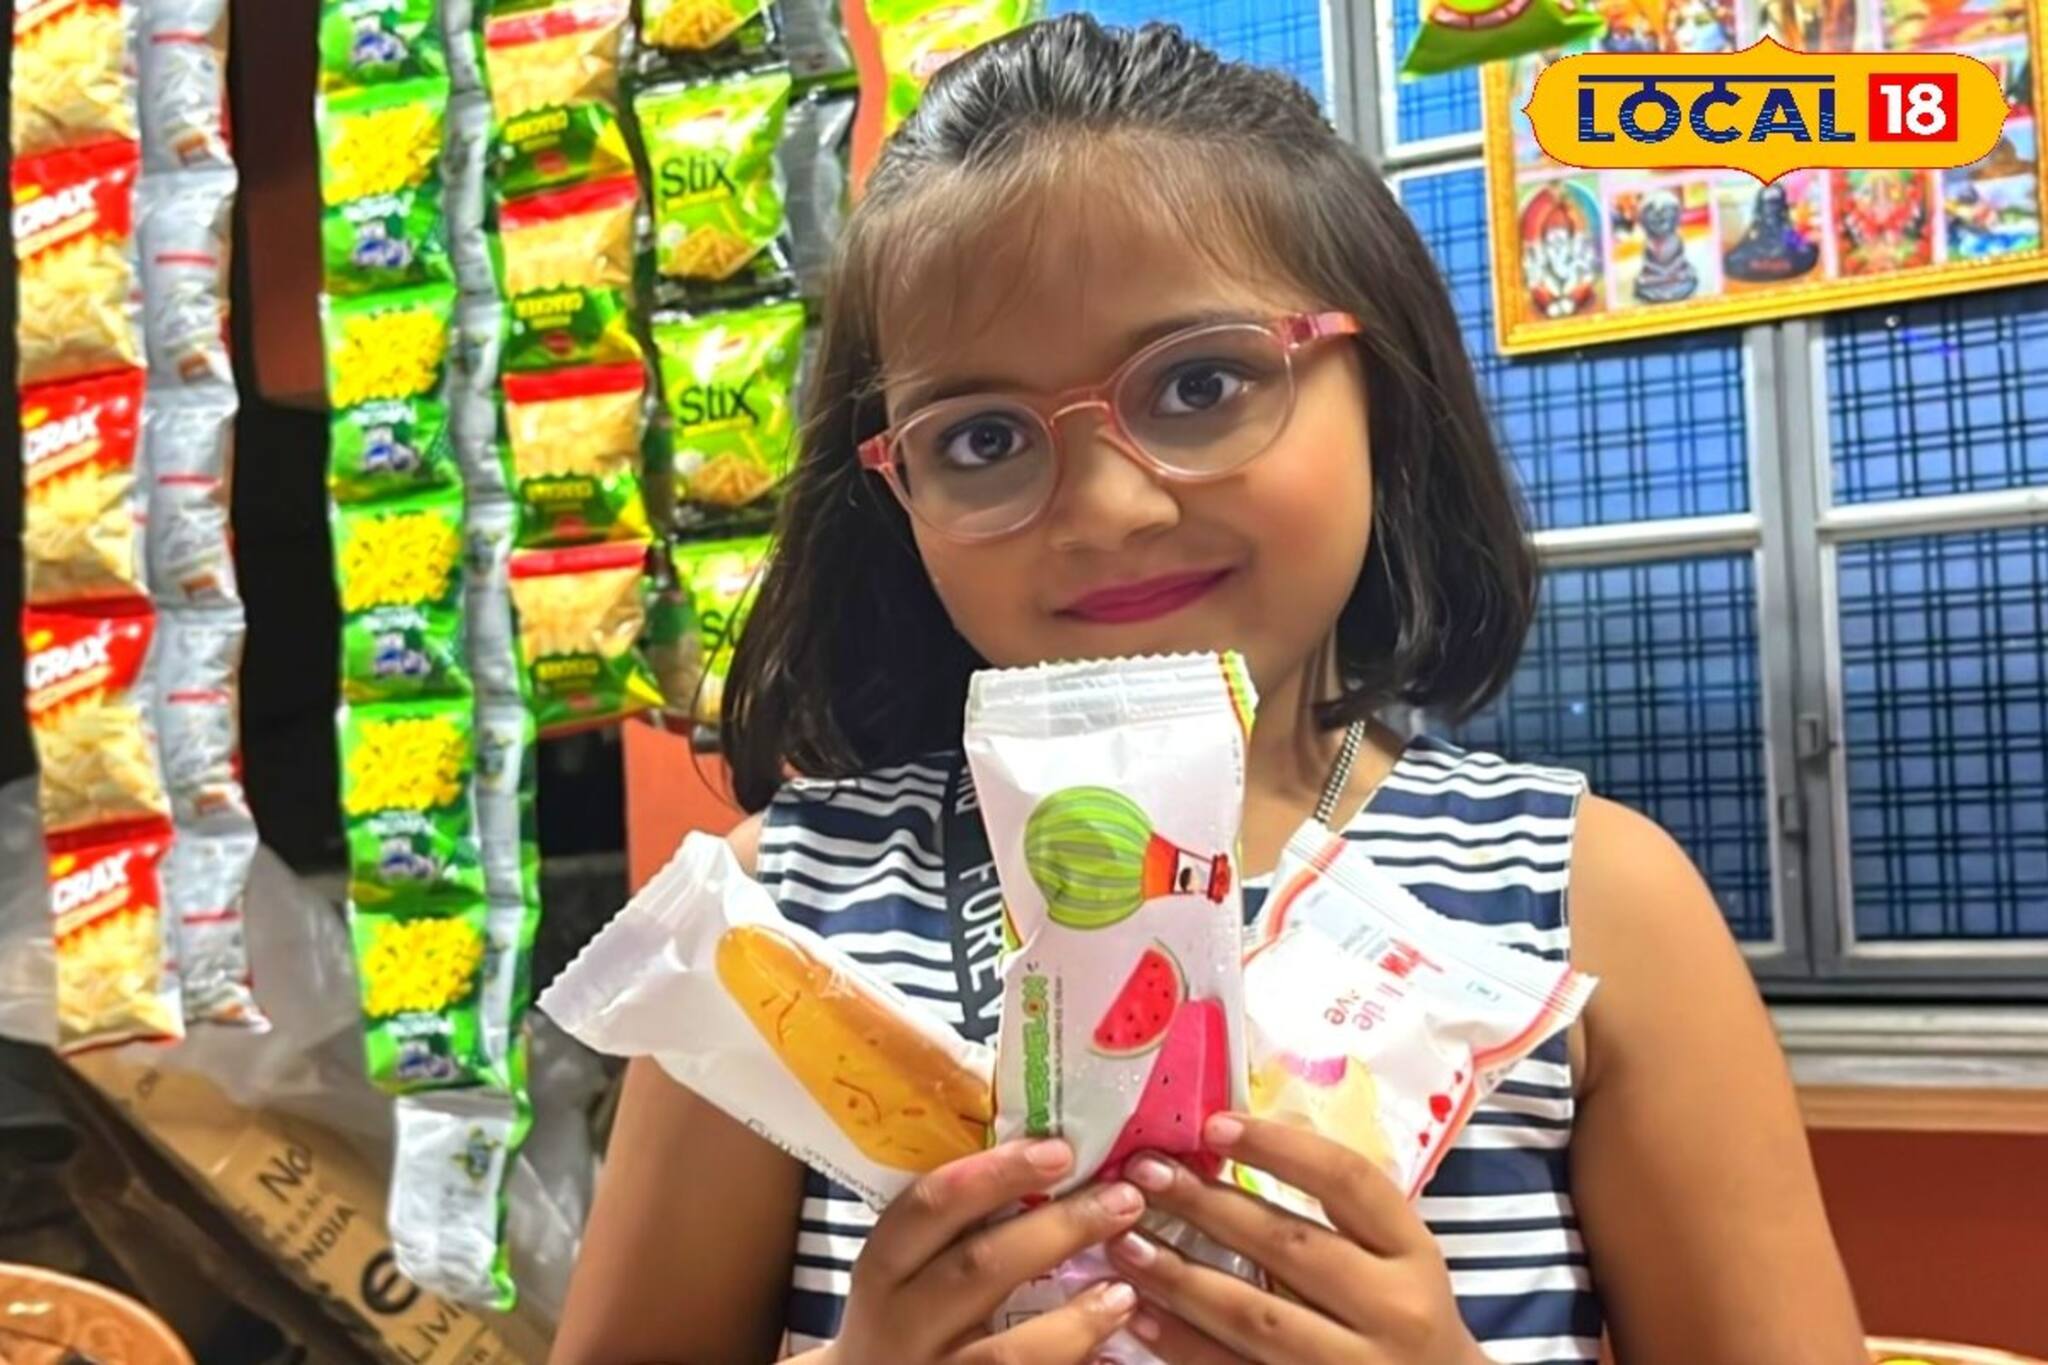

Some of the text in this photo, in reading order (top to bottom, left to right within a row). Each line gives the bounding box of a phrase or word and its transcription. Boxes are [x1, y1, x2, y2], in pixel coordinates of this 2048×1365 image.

[661, 147, 737, 198] Stix
[12, 178, 99, 238] CRAX
[679, 372, 760, 427] Stix
[23, 405, 101, 463] CRAX
[26, 621, 112, 690] CRAX
[53, 850, 131, 913] CRAX
